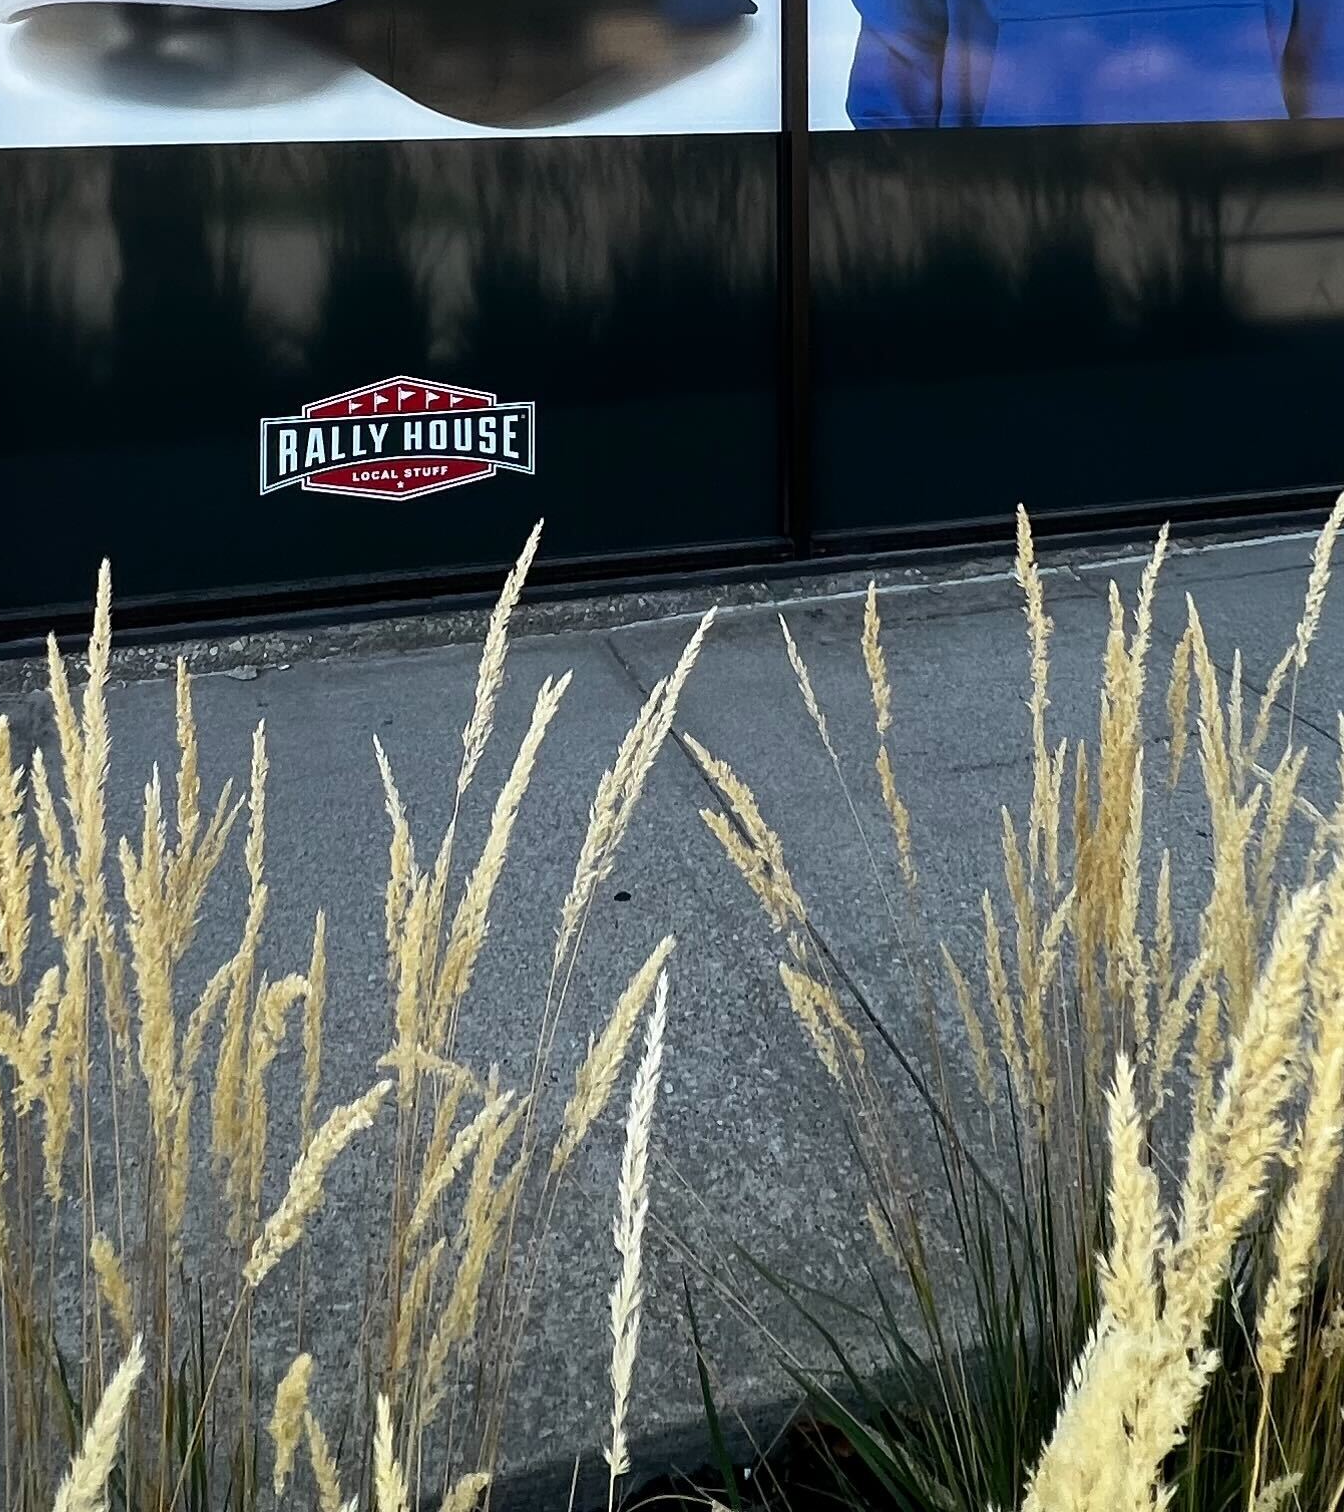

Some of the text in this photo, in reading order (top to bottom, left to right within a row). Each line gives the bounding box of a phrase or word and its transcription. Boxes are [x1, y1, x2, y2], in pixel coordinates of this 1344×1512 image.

[278, 414, 520, 476] RALLY HOUSE
[352, 465, 449, 483] LOCAL STUFF
